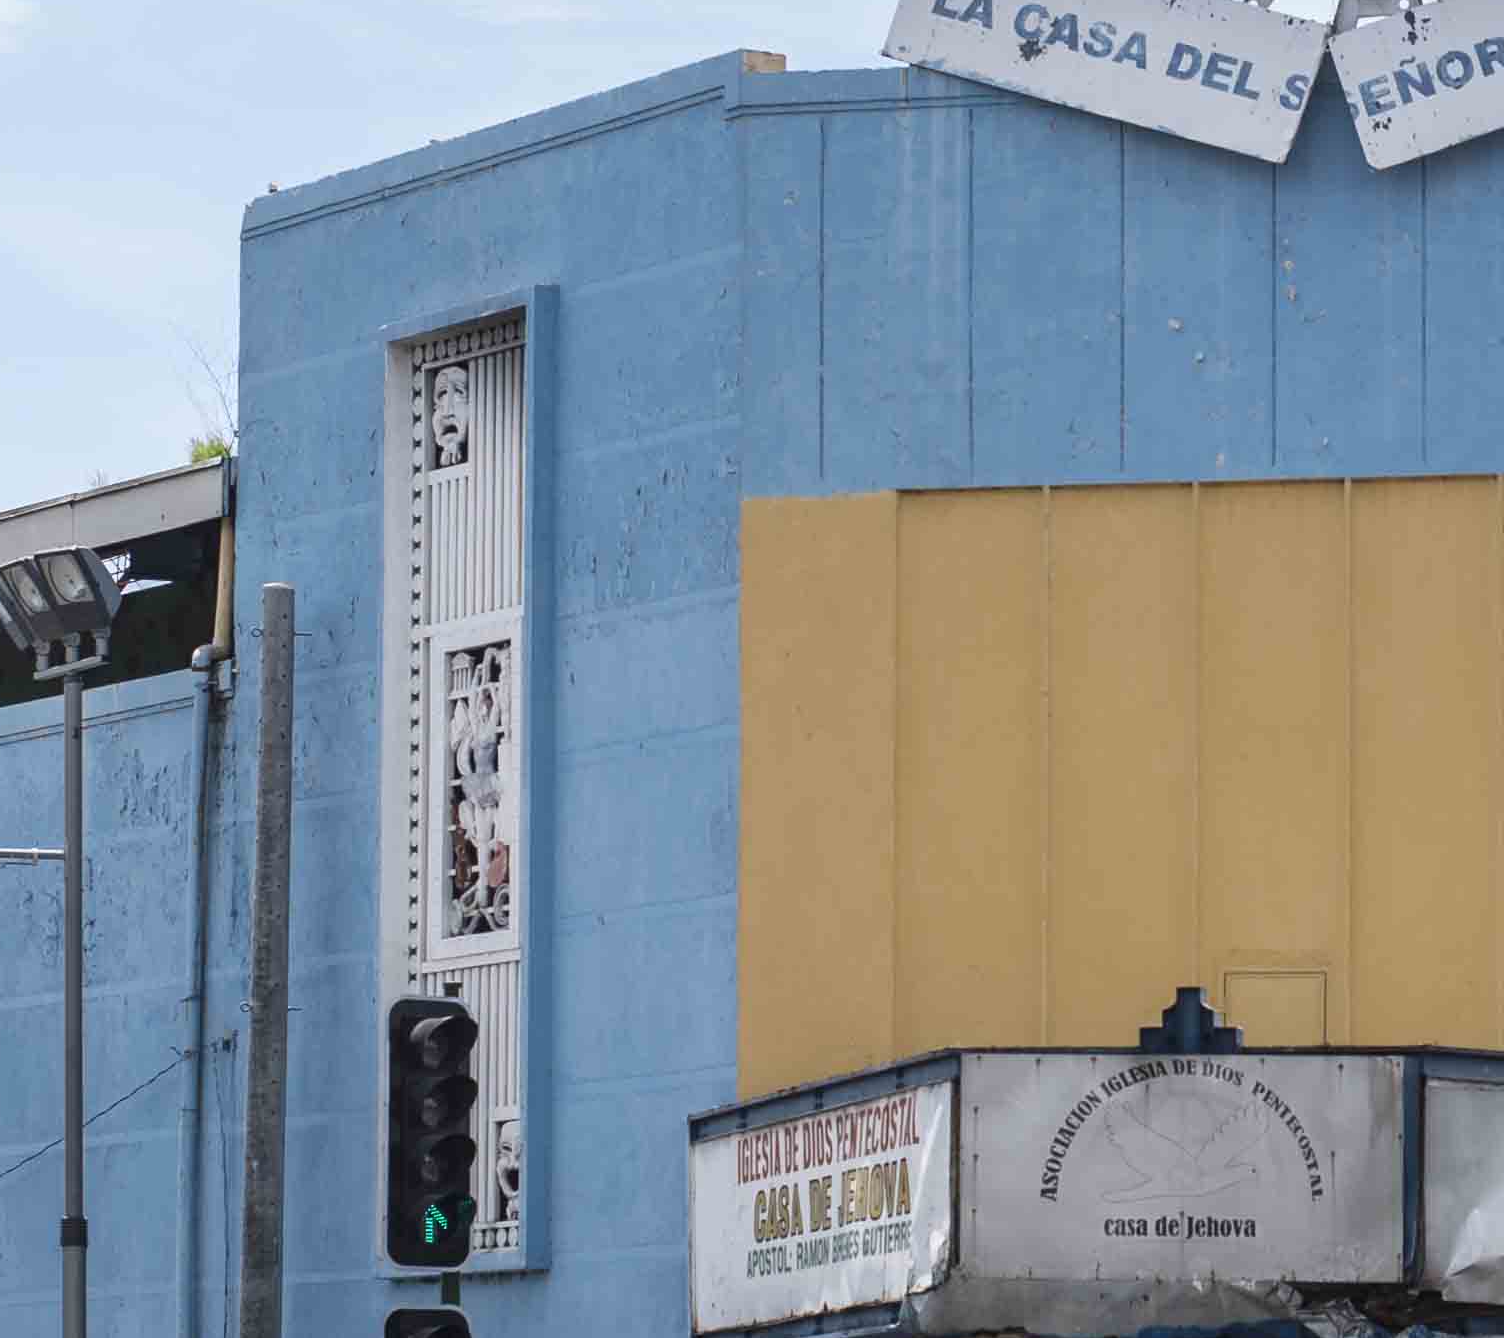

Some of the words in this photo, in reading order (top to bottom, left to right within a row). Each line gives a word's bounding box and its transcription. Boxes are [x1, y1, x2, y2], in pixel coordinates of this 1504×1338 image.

[1013, 3, 1147, 69] CASA
[1165, 41, 1260, 101] DEL
[737, 1127, 781, 1185] IGLESIA
[785, 1123, 799, 1173] DE
[802, 1115, 832, 1168] DIOS
[836, 1096, 920, 1161] PENTECOSTAL
[1040, 1091, 1102, 1202] ASOCIACION
[1100, 1061, 1168, 1097] IGLESIA
[1171, 1059, 1197, 1076] DE
[1202, 1060, 1245, 1088] DIOS
[1251, 1080, 1323, 1202] PENTECOSTAL
[754, 1182, 804, 1244] CASA
[809, 1175, 832, 1232] DE
[837, 1158, 911, 1227] JEHOVA
[1104, 1217, 1147, 1237] casa
[1155, 1215, 1179, 1237] de
[1186, 1215, 1256, 1239] Jehova
[796, 1235, 829, 1270] RAMON
